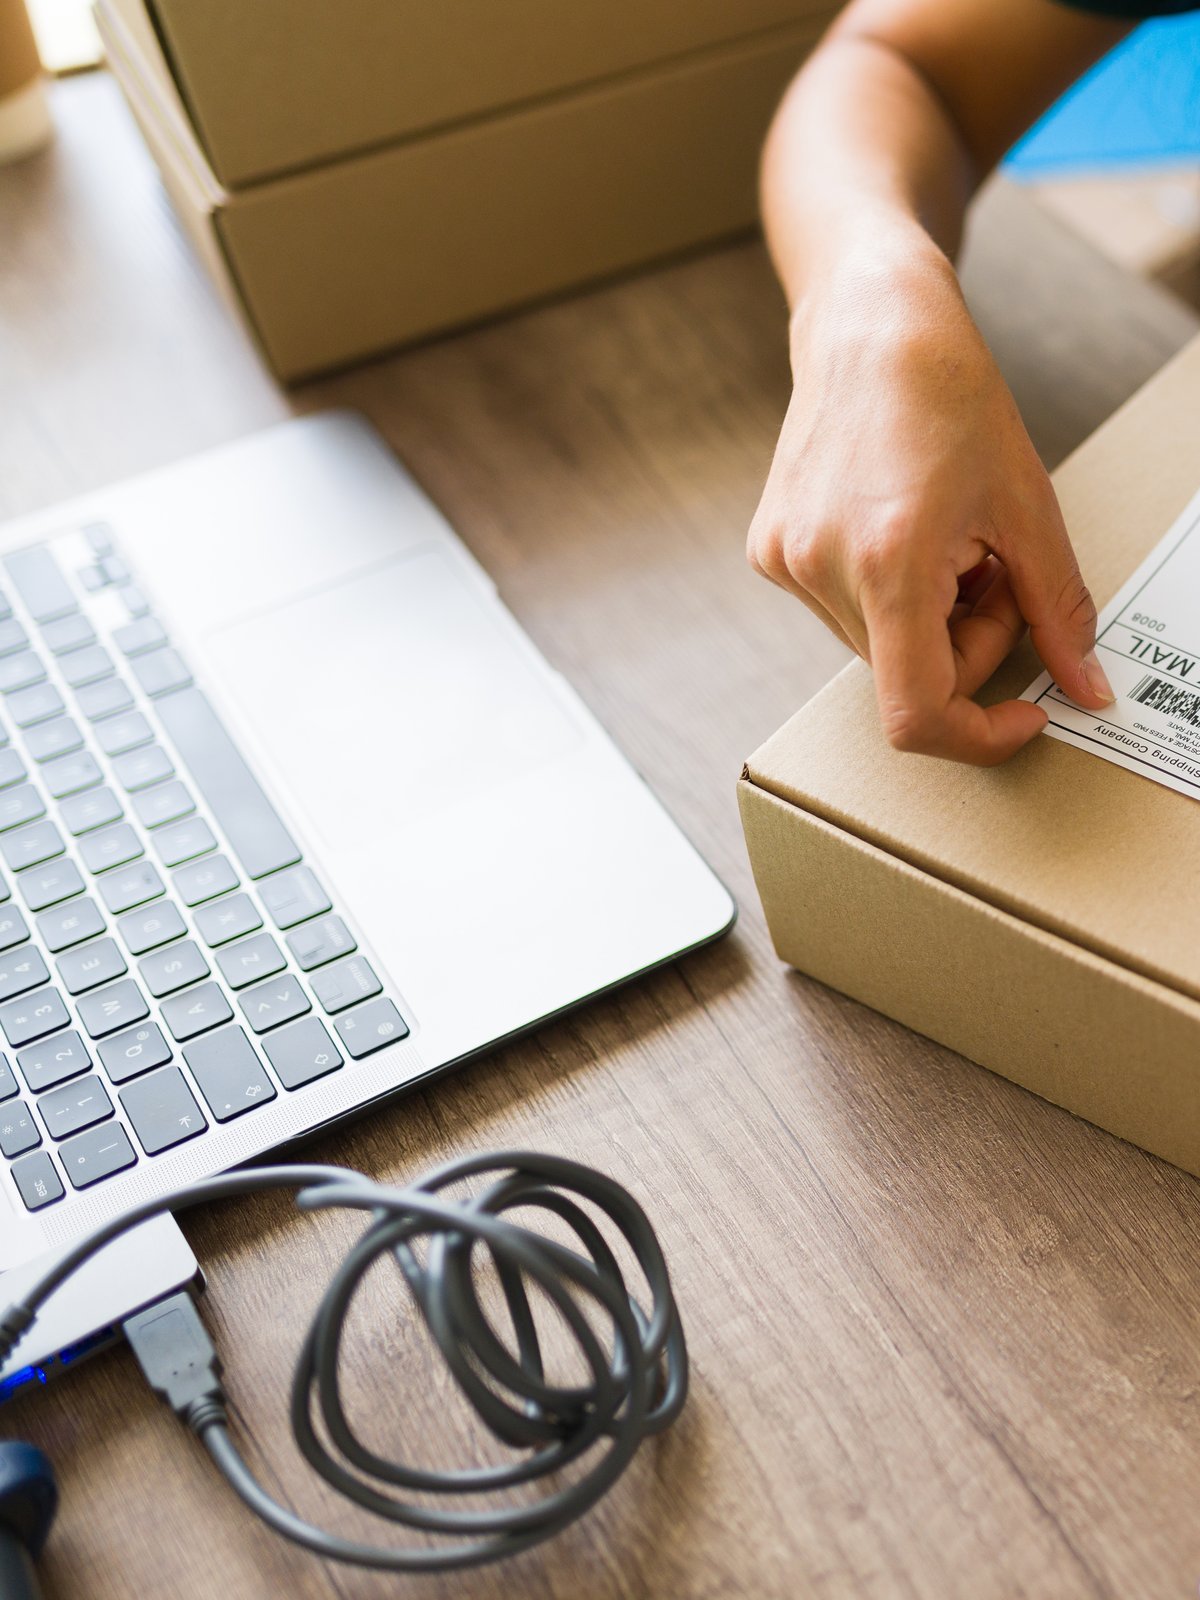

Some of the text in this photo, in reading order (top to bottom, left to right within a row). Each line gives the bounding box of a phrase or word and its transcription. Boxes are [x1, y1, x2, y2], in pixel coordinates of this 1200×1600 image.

[1131, 612, 1166, 632] 0008
[1129, 635, 1196, 677] MAIL
[1132, 722, 1153, 734] PAID
[1166, 721, 1186, 733] RATE
[1093, 724, 1149, 753] Company
[1150, 729, 1168, 741] FEES
[1174, 732, 1191, 743] MAIL
[81, 958, 100, 971] E
[240, 952, 260, 966] Z
[164, 960, 182, 973] S
[34, 1004, 52, 1017] 3
[101, 1000, 121, 1016] W
[187, 1002, 205, 1014] A
[55, 1048, 73, 1061] 2
[125, 1043, 142, 1057] Q
[77, 1096, 93, 1106] 1
[34, 1179, 48, 1197] esc
